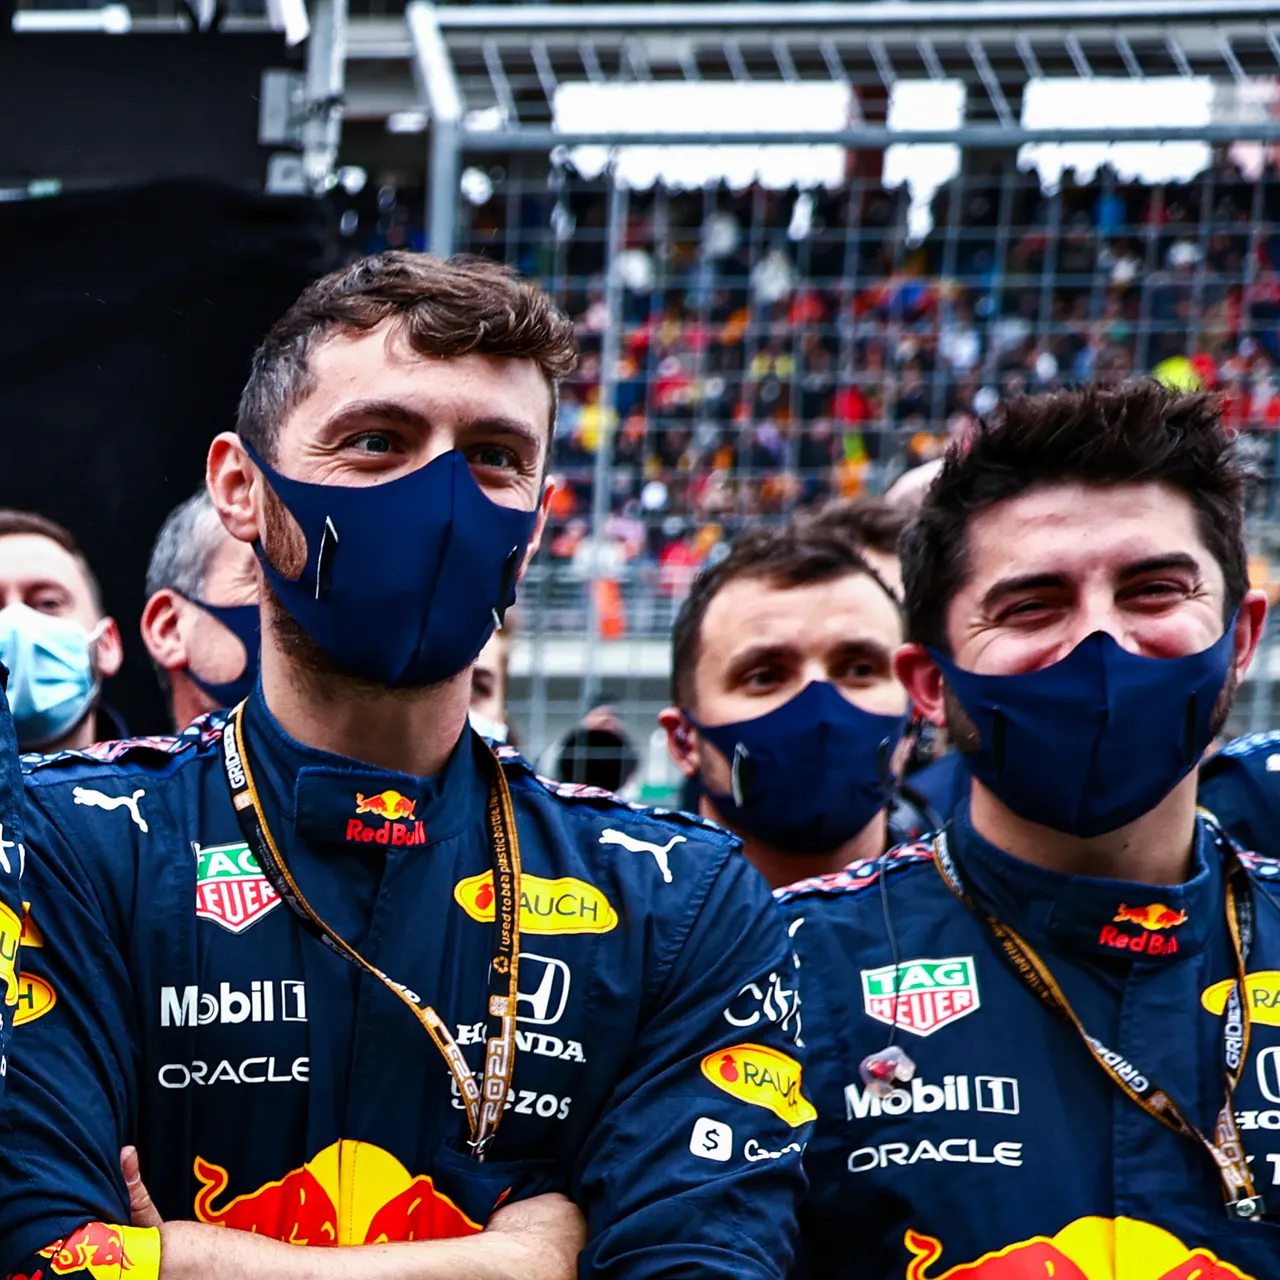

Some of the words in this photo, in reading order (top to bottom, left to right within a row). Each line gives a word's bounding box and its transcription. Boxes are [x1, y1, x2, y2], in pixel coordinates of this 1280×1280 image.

[346, 819, 391, 843] Red
[392, 821, 427, 845] Bull
[196, 881, 277, 923] EUER
[1098, 925, 1145, 955] Red
[868, 963, 964, 993] TAG
[160, 981, 273, 1029] Mobil
[870, 992, 972, 1031] HEUER
[455, 1021, 587, 1063] HNDA
[157, 1055, 309, 1090] ORACLE
[743, 1061, 798, 1108] RAU
[503, 1088, 572, 1120] ezos
[843, 1074, 970, 1122] Mobil
[846, 1137, 1023, 1174] ORACLE
